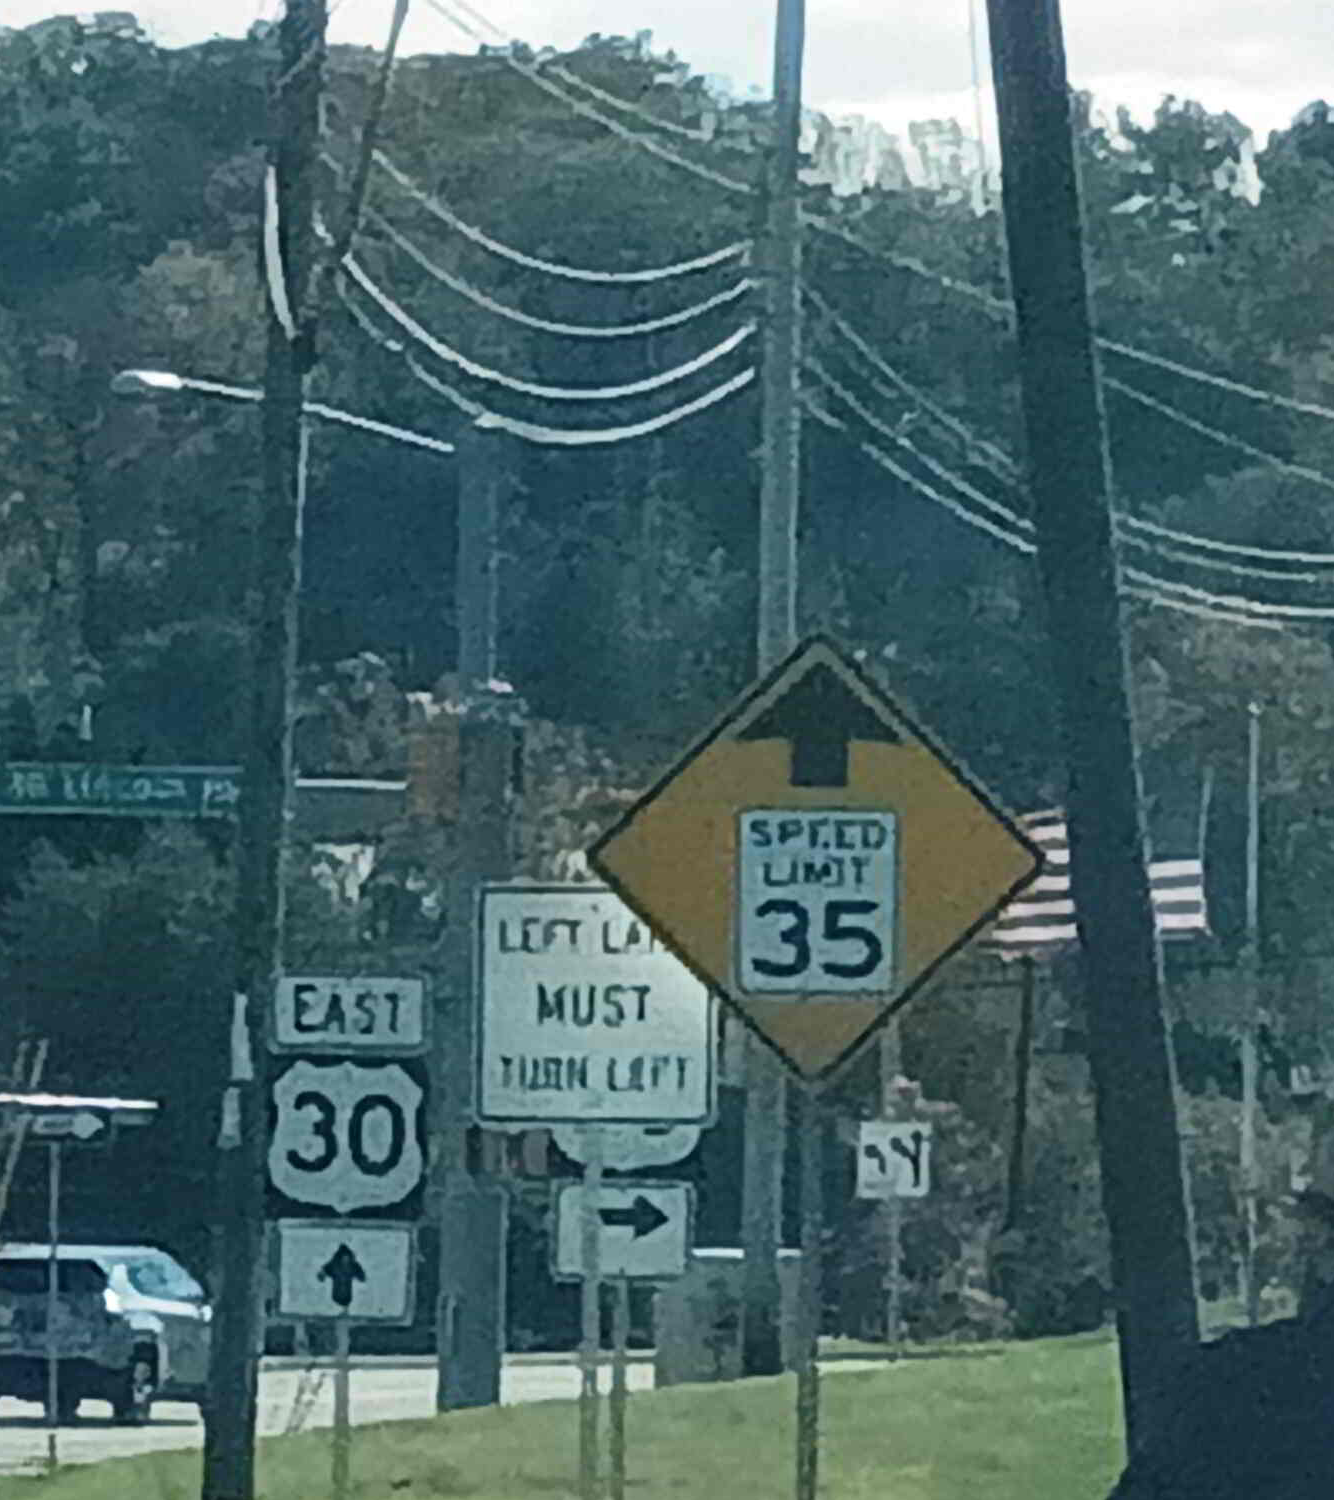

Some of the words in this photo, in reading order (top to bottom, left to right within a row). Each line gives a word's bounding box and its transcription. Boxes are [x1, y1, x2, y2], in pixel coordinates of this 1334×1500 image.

[749, 817, 888, 850] SPEED
[762, 855, 871, 891] LIMIT
[499, 916, 582, 954] LEFT
[750, 898, 884, 979] 35
[293, 983, 400, 1035] EAST
[536, 982, 652, 1028] MUST
[499, 1055, 589, 1092] TURN
[606, 1055, 694, 1093] LEFT
[285, 1090, 406, 1177] 30
